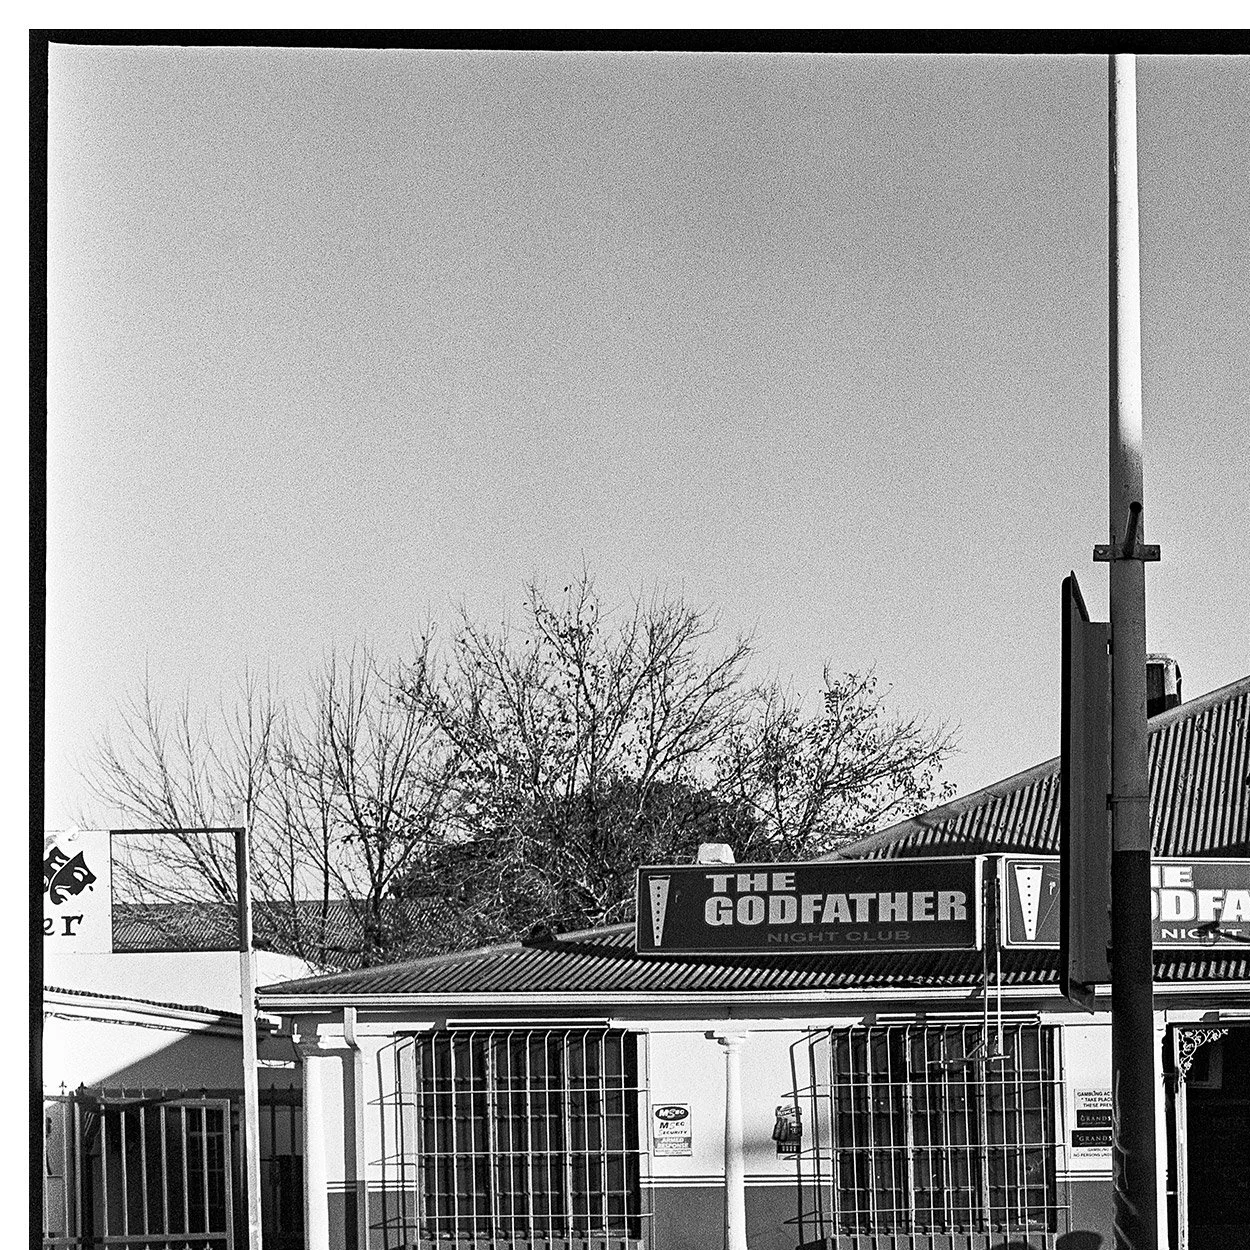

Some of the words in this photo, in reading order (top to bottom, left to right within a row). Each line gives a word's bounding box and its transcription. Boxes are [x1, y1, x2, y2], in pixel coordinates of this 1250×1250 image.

[705, 872, 796, 893] THE
[704, 891, 967, 926] GODFATHER
[767, 931, 839, 943] NIGHT
[845, 929, 911, 942] CLUB
